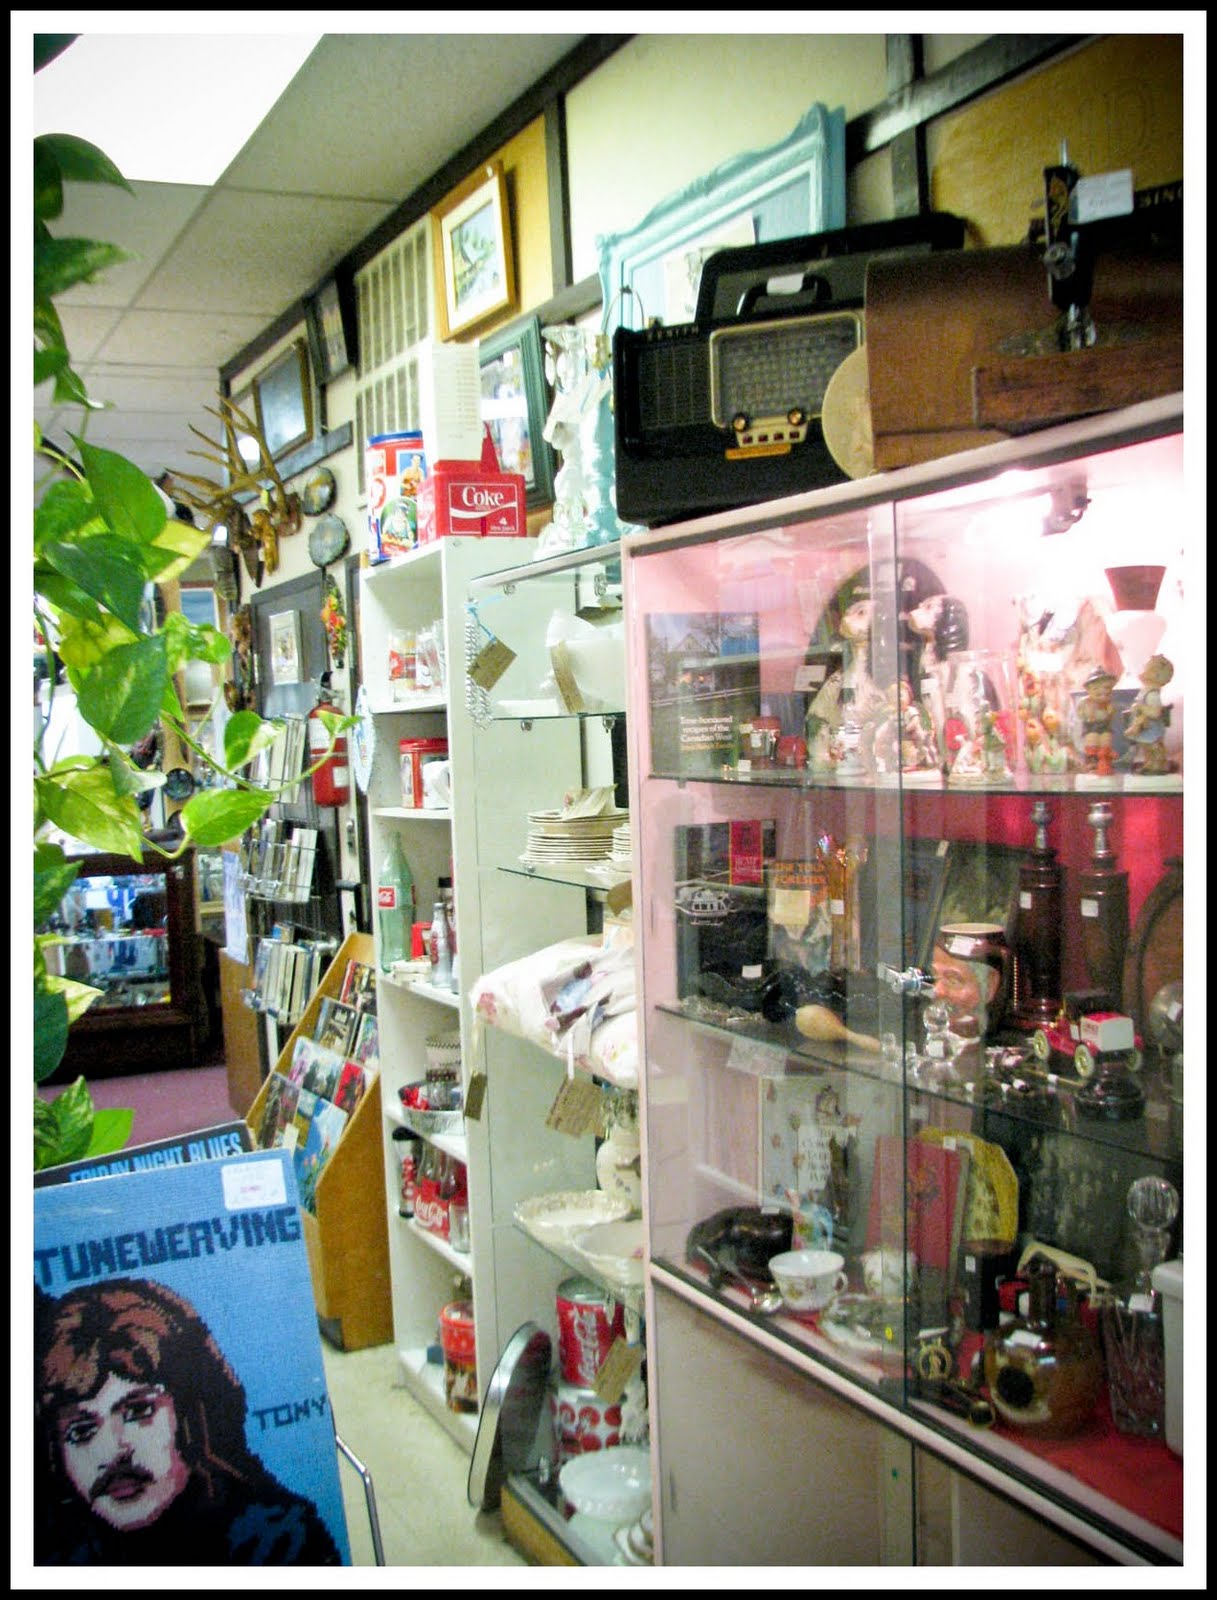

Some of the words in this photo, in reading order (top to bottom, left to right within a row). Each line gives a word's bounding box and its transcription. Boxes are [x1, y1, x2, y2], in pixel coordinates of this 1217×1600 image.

[462, 486, 504, 507] Coke
[132, 1145, 184, 1172] NIGHT
[188, 1131, 243, 1163] BLUES
[252, 1396, 328, 1431] TONY
